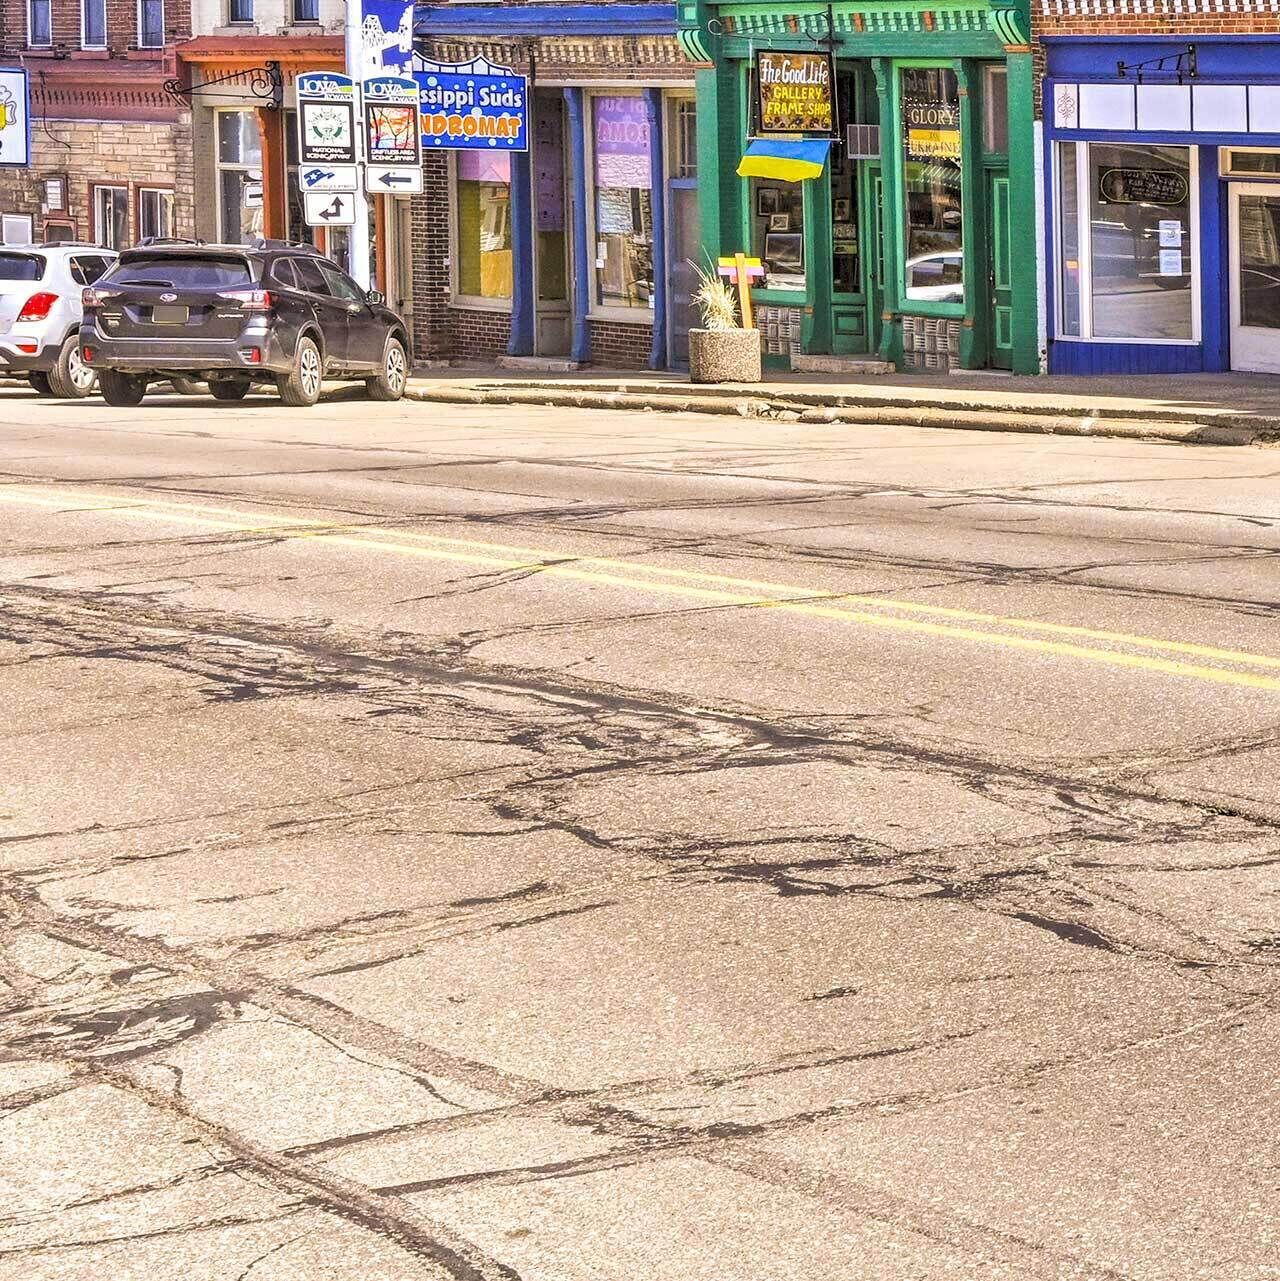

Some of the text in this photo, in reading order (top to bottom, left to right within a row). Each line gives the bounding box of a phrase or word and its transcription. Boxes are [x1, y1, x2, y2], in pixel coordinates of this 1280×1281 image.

[760, 58, 828, 85] The Good Life
[420, 85, 522, 109] ssippi Suds
[773, 86, 822, 100] GALLERY
[767, 102, 831, 115] FRAME SHOP
[910, 108, 955, 125] GLORY
[420, 113, 522, 138] NDROMAT
